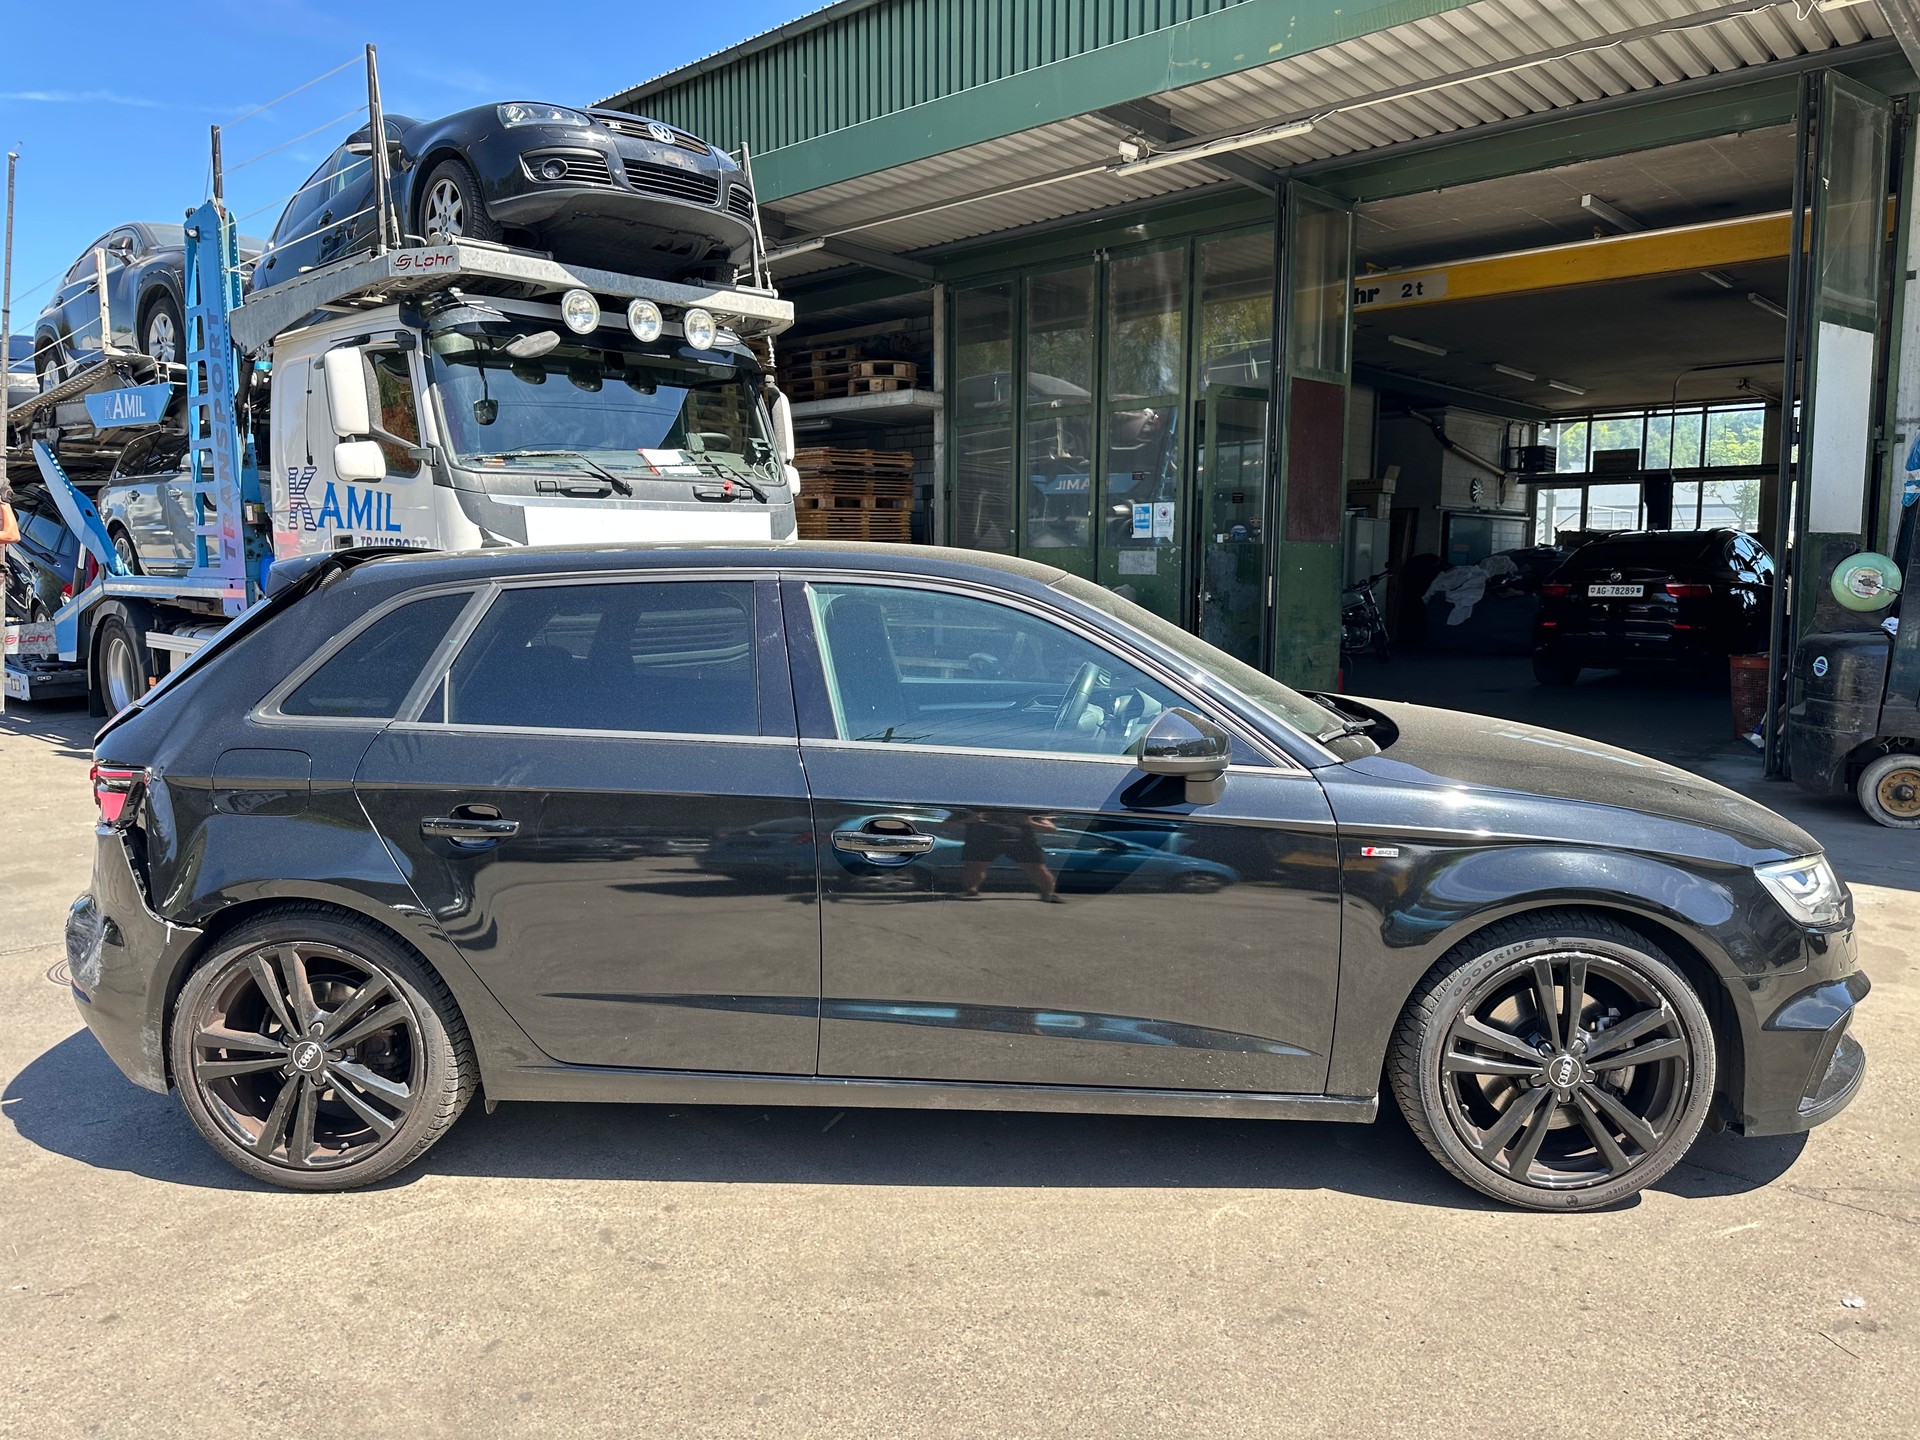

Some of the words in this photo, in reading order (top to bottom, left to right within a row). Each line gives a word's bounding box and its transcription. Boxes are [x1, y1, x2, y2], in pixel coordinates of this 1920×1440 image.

[414, 254, 454, 268] Lohr
[1354, 287, 1380, 305] hr
[1401, 283, 1413, 298] 2
[1416, 281, 1423, 296] t
[104, 392, 146, 420] KAMIL
[206, 308, 236, 561] TRANSPORT
[288, 466, 402, 532] KAMIL
[18, 633, 52, 644] Lohr
[1453, 940, 1535, 998] GOODRIDE
